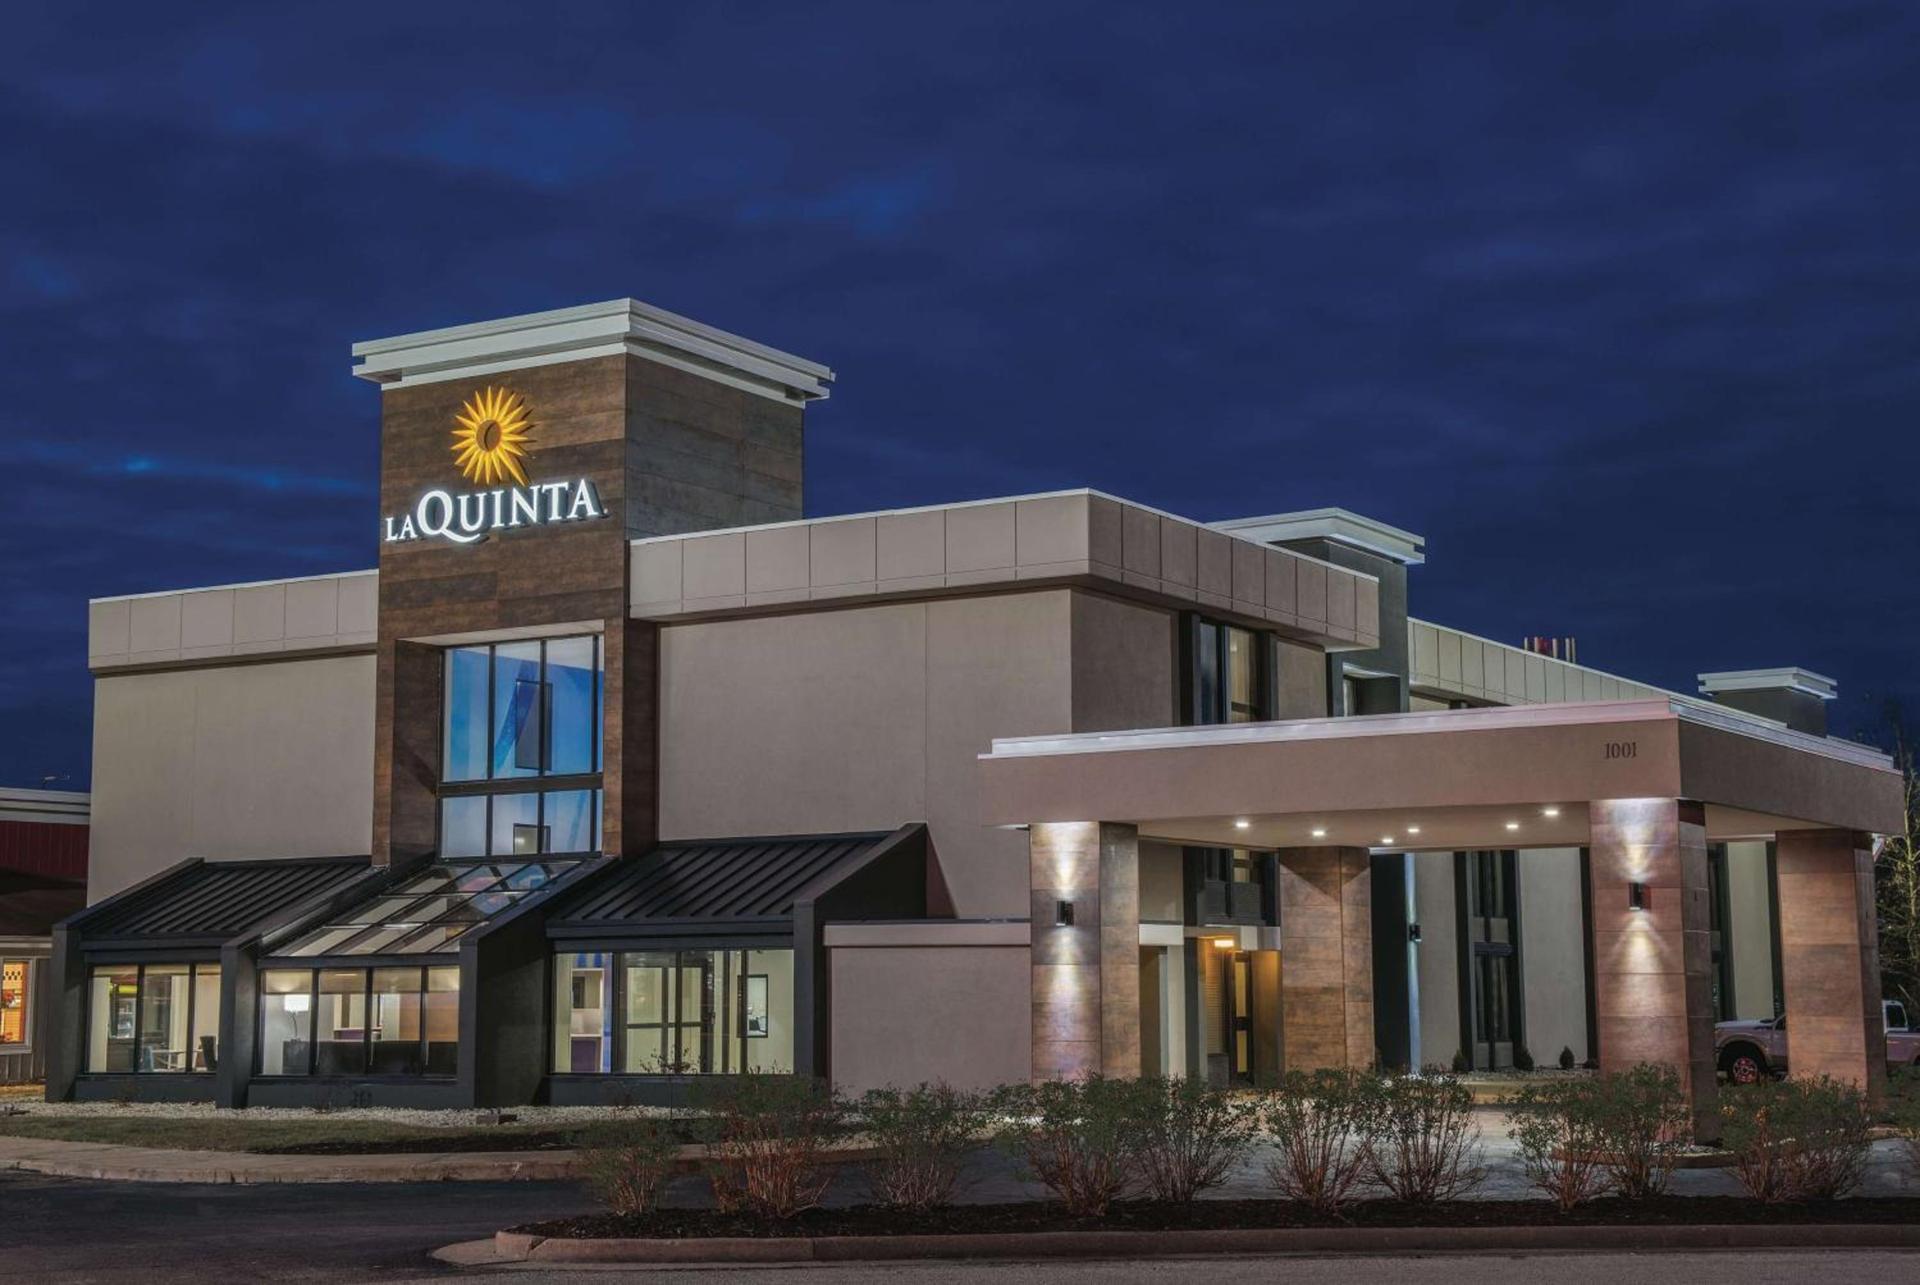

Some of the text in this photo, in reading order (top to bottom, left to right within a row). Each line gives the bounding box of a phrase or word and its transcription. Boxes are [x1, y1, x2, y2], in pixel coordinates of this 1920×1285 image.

[385, 478, 599, 543] LA QUINTA
[1604, 741, 1637, 759] 1001
